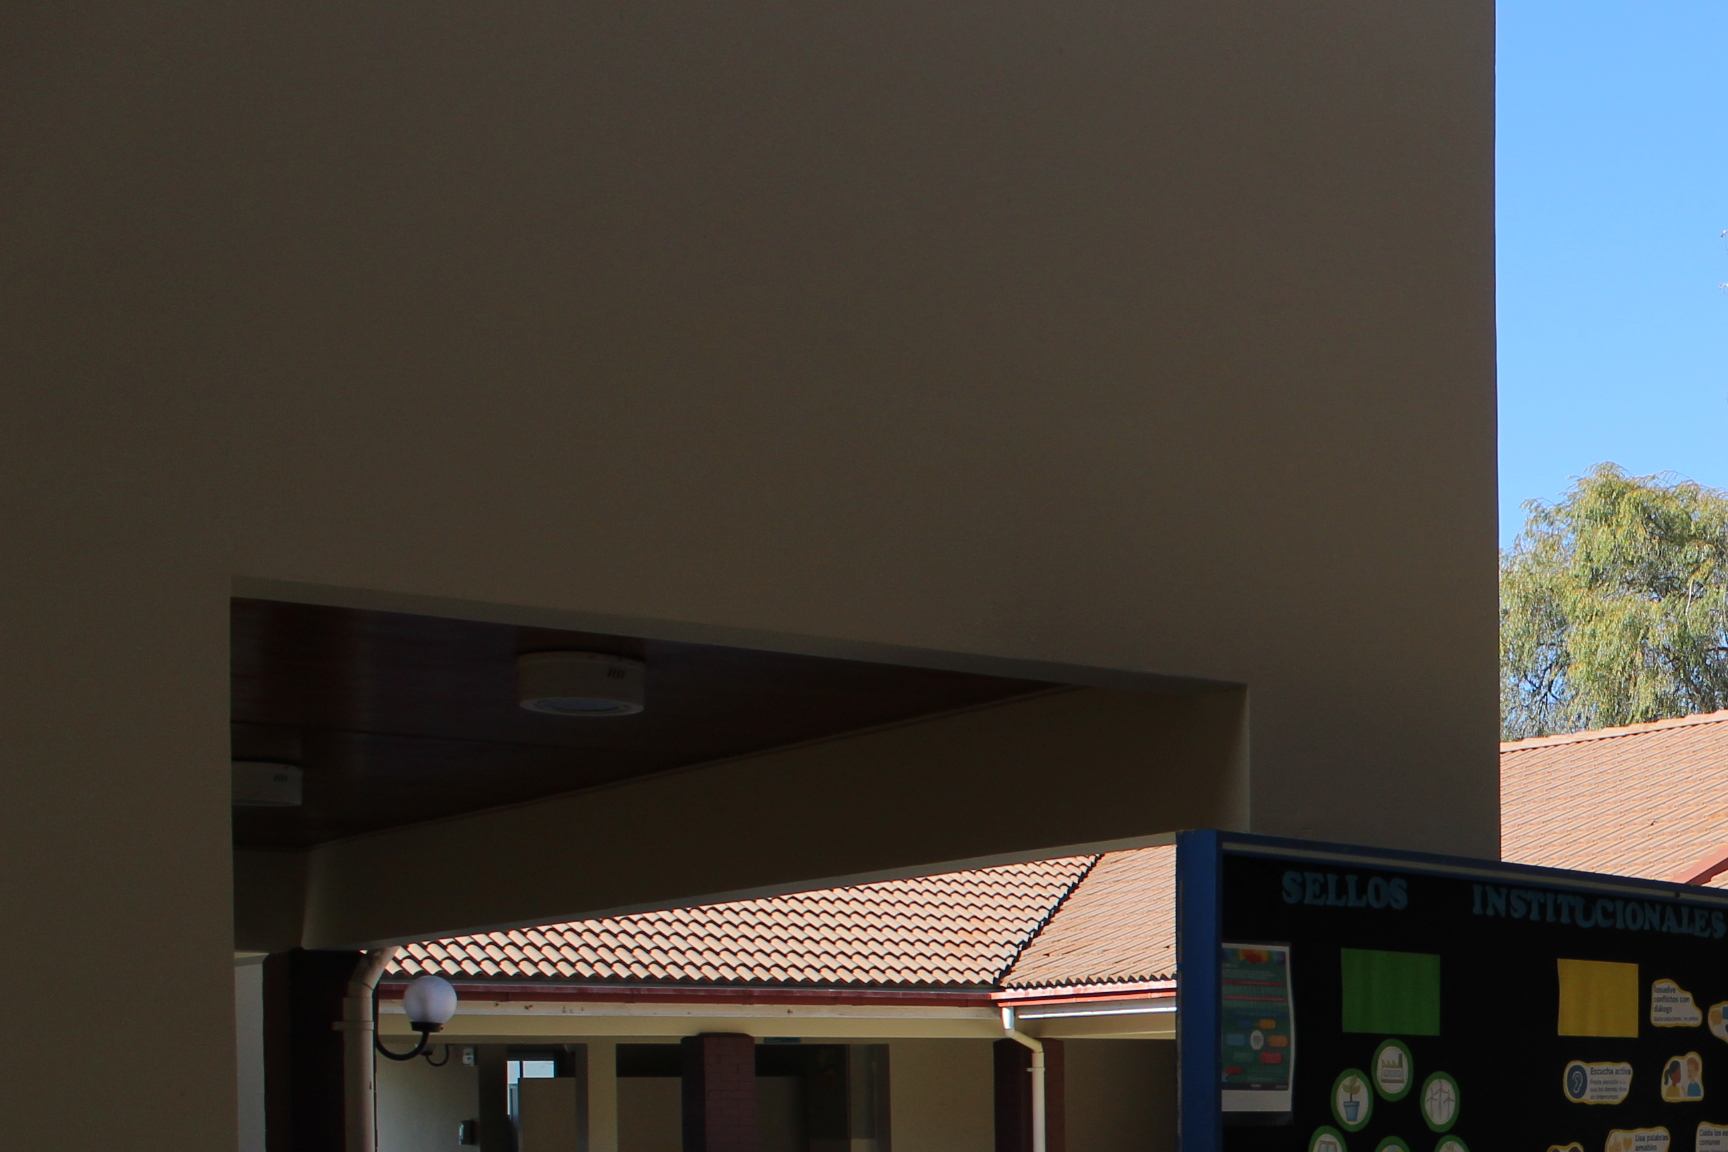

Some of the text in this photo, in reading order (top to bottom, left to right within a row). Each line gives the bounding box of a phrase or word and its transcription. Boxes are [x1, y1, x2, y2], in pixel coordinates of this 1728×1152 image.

[1281, 869, 1728, 940] SELLOS INSTITUCIONALES
[1590, 1067, 1614, 1075] Escucha
[1646, 1134, 1669, 1143] palabras
